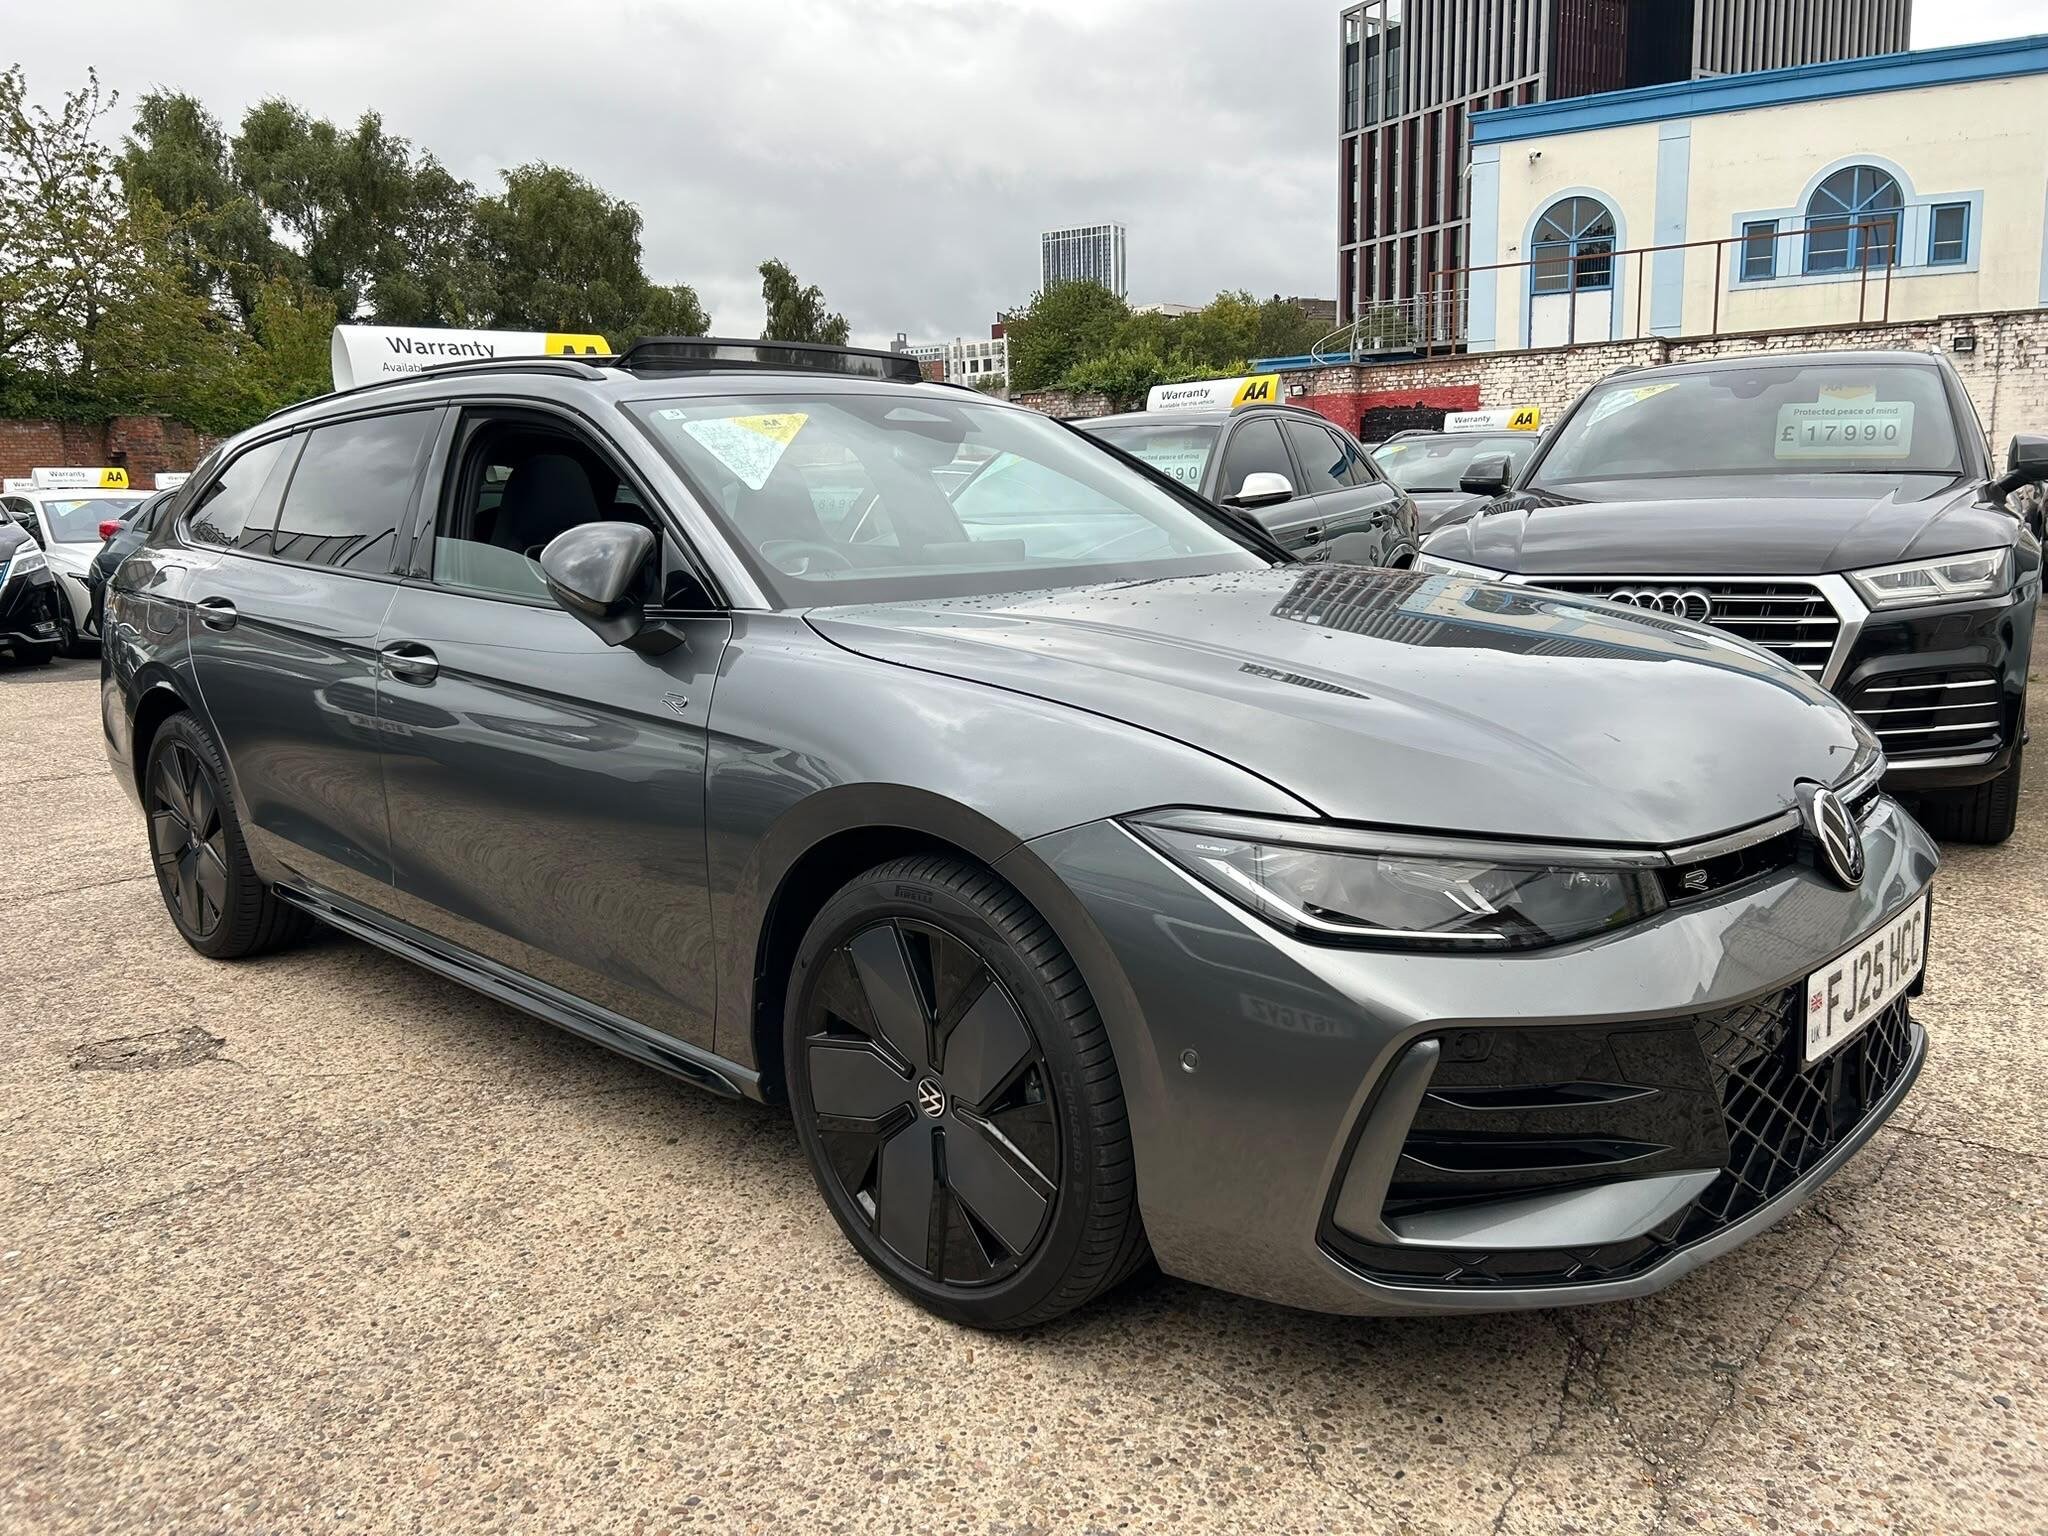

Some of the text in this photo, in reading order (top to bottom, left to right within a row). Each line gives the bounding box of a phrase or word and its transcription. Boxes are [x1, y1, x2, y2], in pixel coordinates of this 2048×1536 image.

[385, 336, 494, 358] Warranty
[1161, 388, 1211, 400] Warranty
[1242, 381, 1269, 401] AA
[1793, 407, 1898, 416] Protected peace of mind
[1454, 415, 1491, 424] Warranty
[1514, 413, 1533, 425] AA
[107, 472, 123, 481] AA
[1826, 910, 1921, 1038] FJ25 HCC
